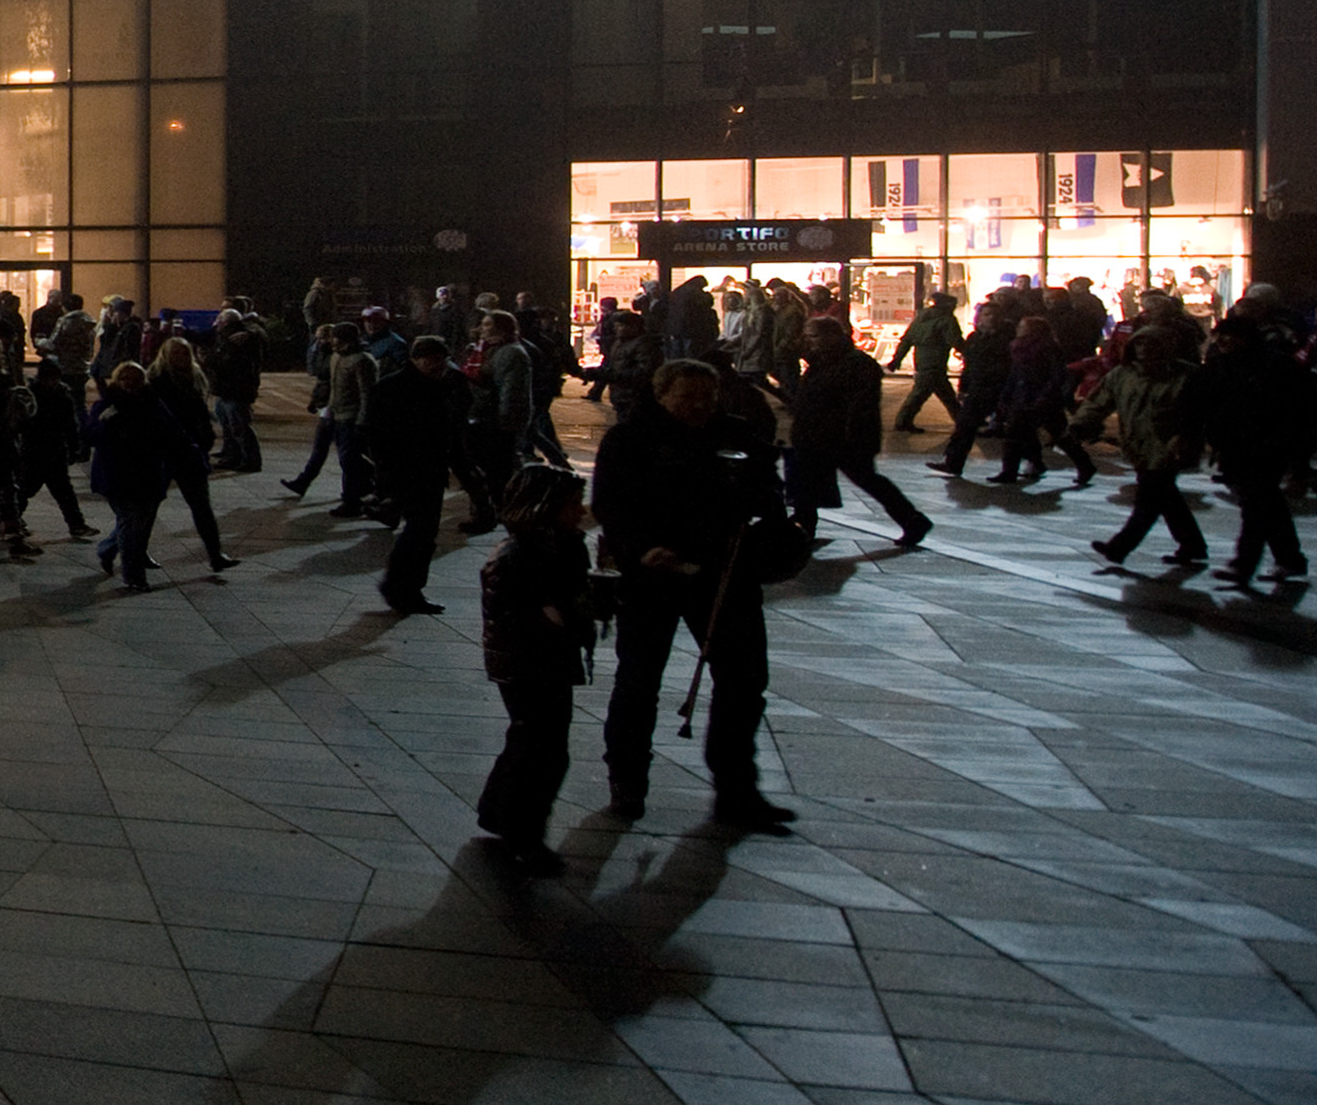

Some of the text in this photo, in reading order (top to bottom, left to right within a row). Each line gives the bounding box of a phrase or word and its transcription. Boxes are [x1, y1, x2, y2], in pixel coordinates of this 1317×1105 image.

[1058, 173, 1073, 204] 1924
[673, 241, 789, 253] ARENA STORE
